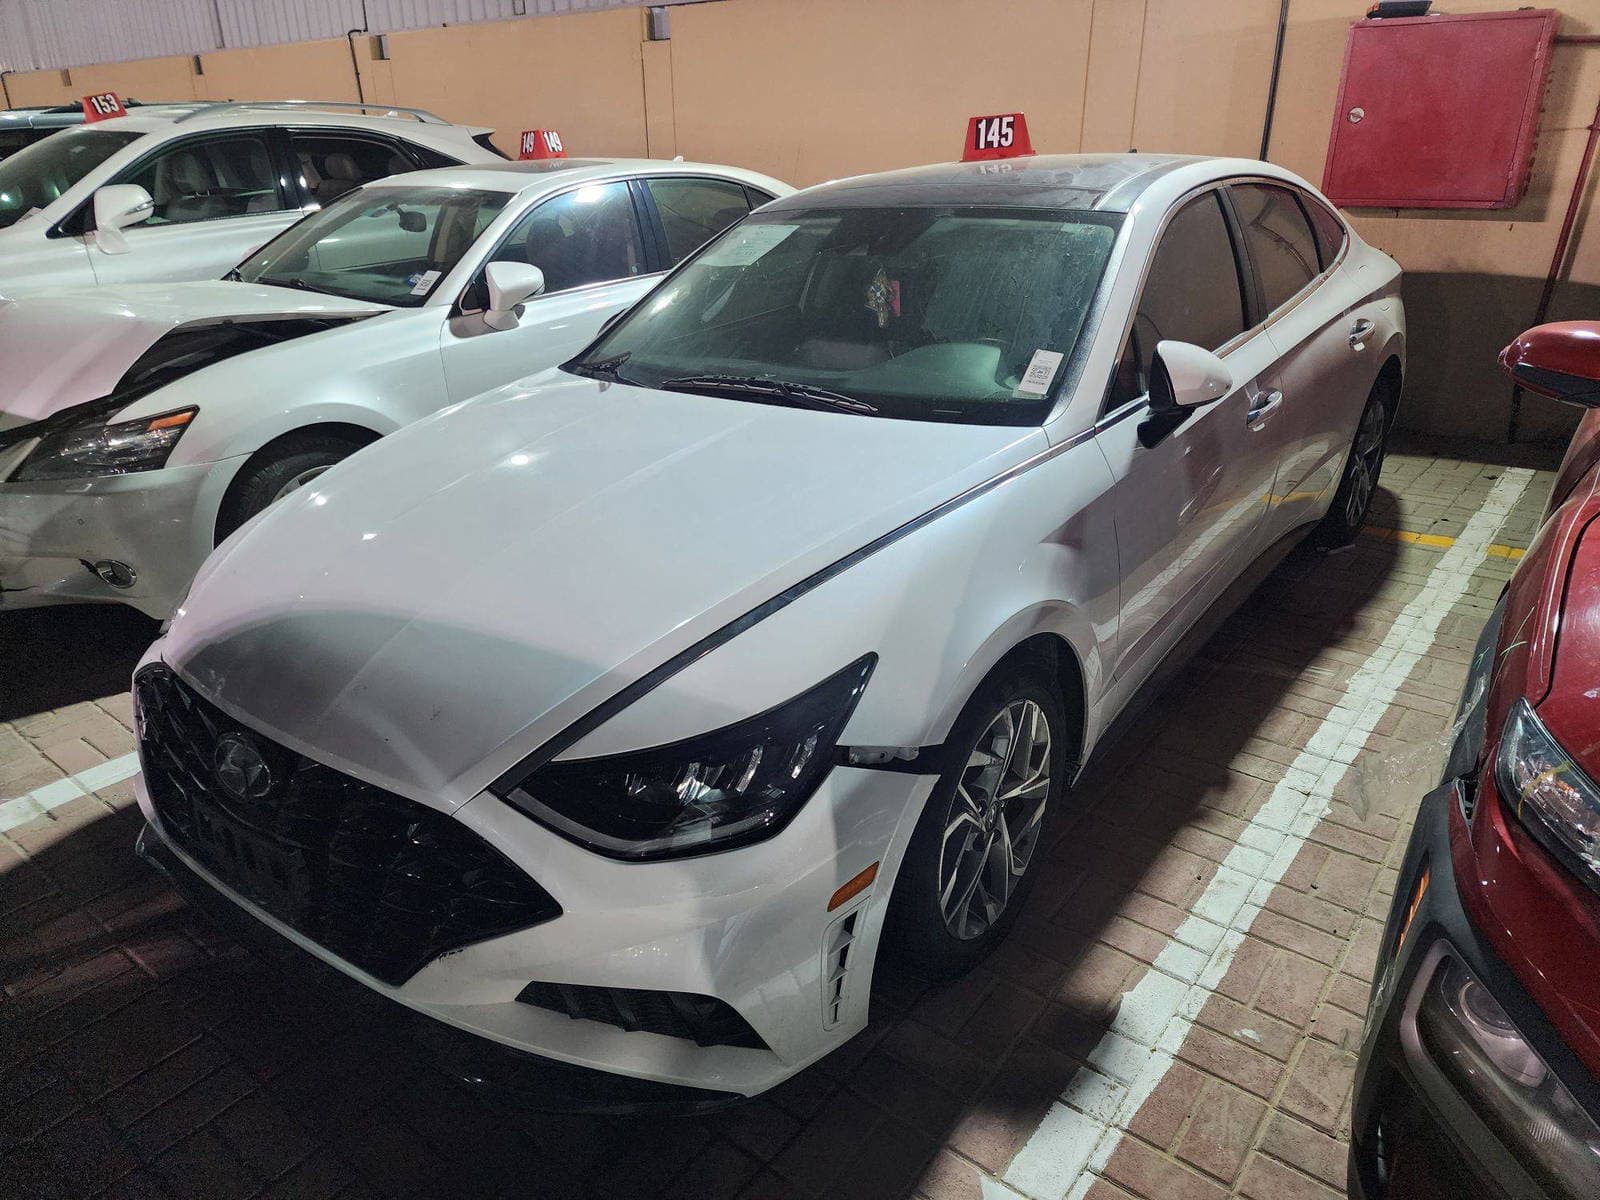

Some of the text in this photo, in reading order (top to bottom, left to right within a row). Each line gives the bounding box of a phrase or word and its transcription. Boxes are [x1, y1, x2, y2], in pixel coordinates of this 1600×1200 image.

[91, 94, 120, 115] 153
[543, 131, 563, 152] 149
[978, 116, 1014, 150] 145
